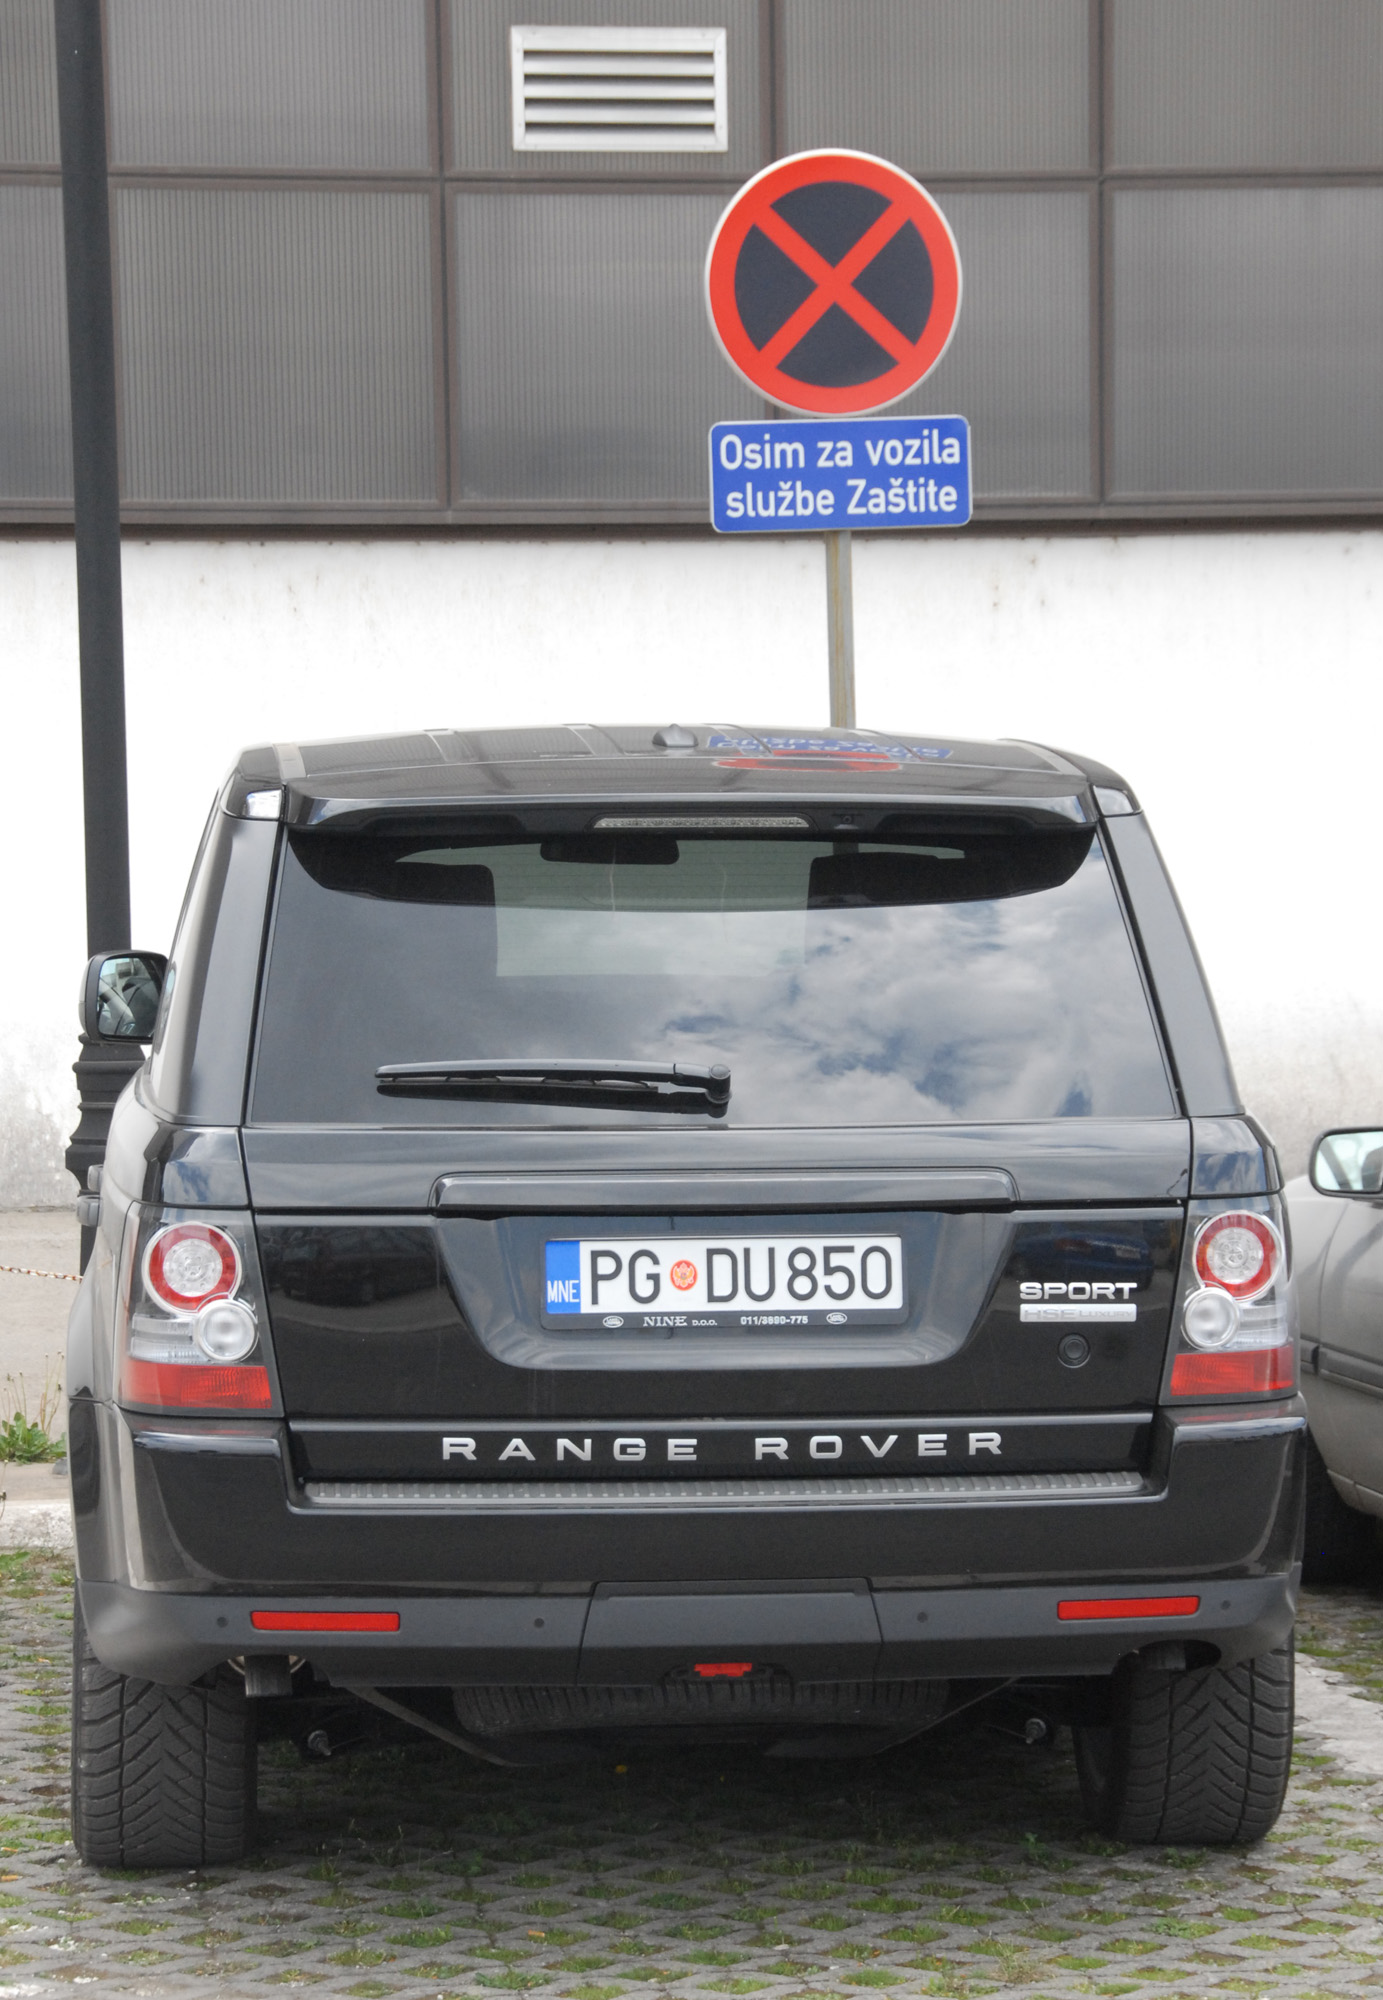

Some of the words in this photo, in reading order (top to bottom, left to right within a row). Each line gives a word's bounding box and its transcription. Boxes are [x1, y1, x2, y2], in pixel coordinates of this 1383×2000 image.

[720, 433, 805, 470] Osim
[816, 440, 853, 468] za
[865, 428, 960, 466] vozila
[726, 481, 835, 518] službe
[846, 477, 958, 515] Zaštite
[547, 1280, 580, 1303] MNE
[590, 1249, 661, 1305] PG
[706, 1246, 893, 1303] DU850
[1020, 1282, 1138, 1300] SPORT
[643, 1316, 687, 1327] NINE
[1024, 1309, 1077, 1320] HSE
[442, 1437, 698, 1461] RANGE
[754, 1432, 1002, 1460] ROVER
